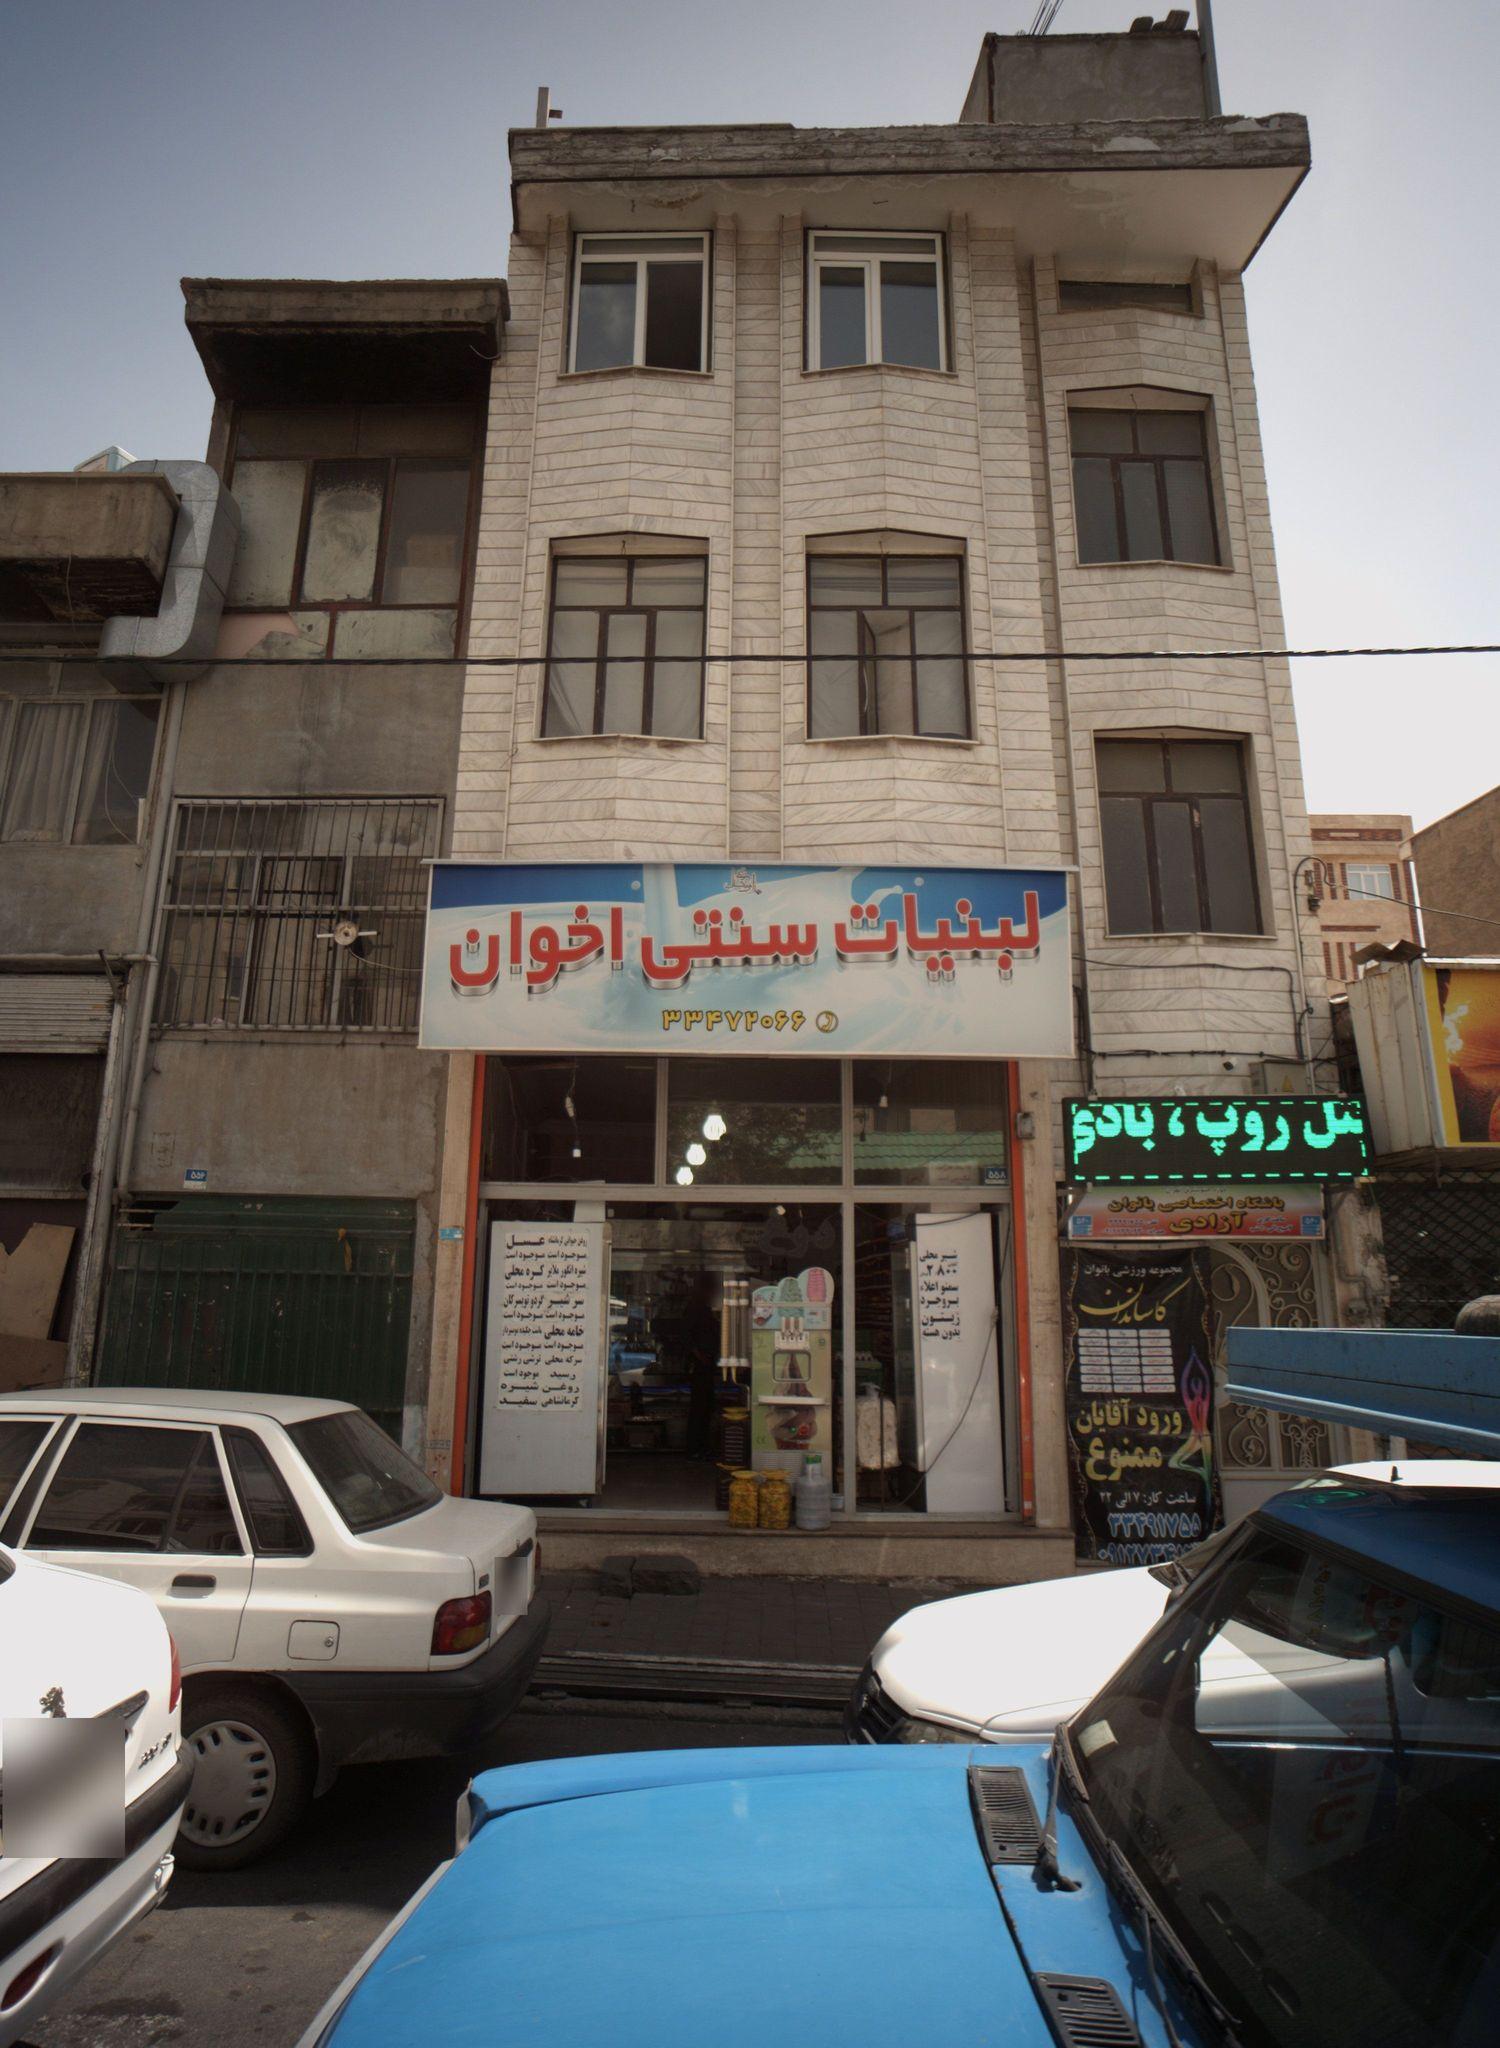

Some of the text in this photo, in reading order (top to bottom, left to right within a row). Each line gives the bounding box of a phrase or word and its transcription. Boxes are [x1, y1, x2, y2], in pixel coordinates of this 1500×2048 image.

[449, 890, 1040, 994] لبنیات سنتی اخوان
[662, 1009, 807, 1032] ۳۳۴۷۲۰۶۶
[1107, 1195, 1285, 1213] باشگاه اختصاصی بانوان
[1168, 1210, 1248, 1235] آزادی
[506, 1234, 545, 1249] عسل
[919, 1250, 958, 1262] شیر محلی
[505, 1264, 544, 1280] کره محلی
[1084, 1263, 1183, 1278] مجموعه ورزشی بانوان
[547, 1293, 570, 1309] شیر
[921, 1311, 960, 1326] زیتون
[544, 1325, 584, 1340] خامه محلی
[544, 1355, 564, 1366] محلی
[500, 1381, 540, 1393] شیره
[542, 1382, 580, 1394] روغن
[499, 1396, 538, 1408] سفید
[1076, 1398, 1183, 1436] ورود آقایان
[1085, 1437, 1163, 1481] ممنوع
[1165, 1491, 1197, 1505] ساعت
